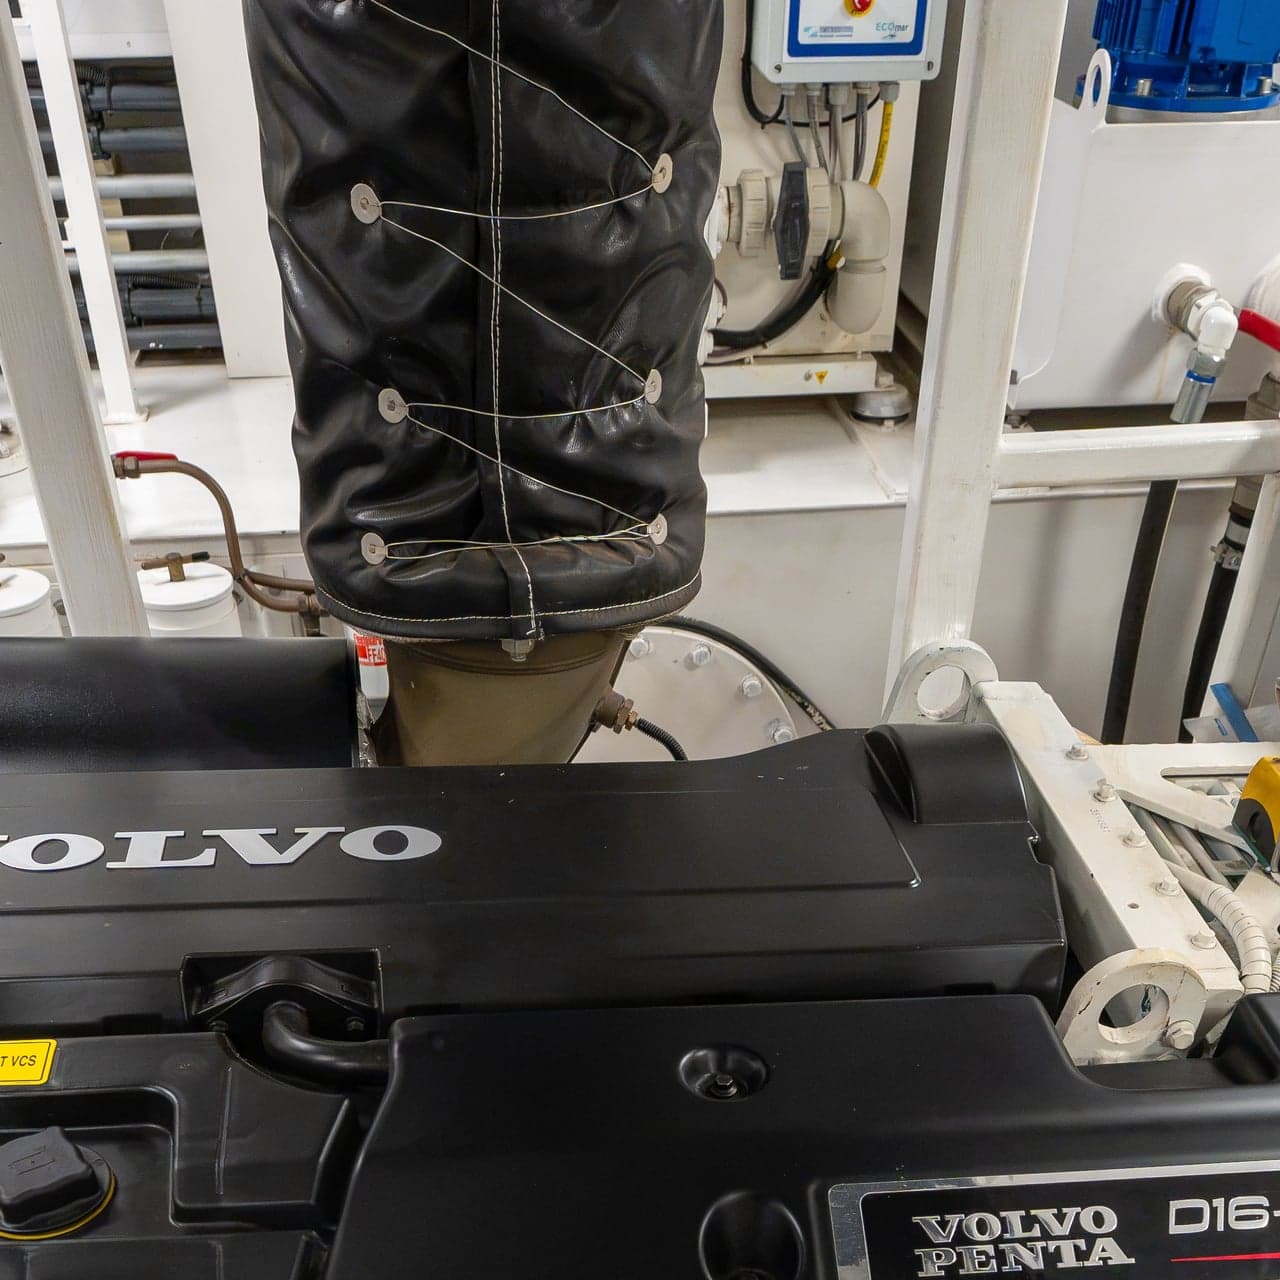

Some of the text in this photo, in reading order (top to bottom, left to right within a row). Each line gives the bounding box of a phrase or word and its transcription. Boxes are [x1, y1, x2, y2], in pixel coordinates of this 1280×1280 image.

[11, 1054, 38, 1068] VCS
[912, 1205, 1119, 1244] VOLVO
[914, 1237, 1136, 1278] PENTA
